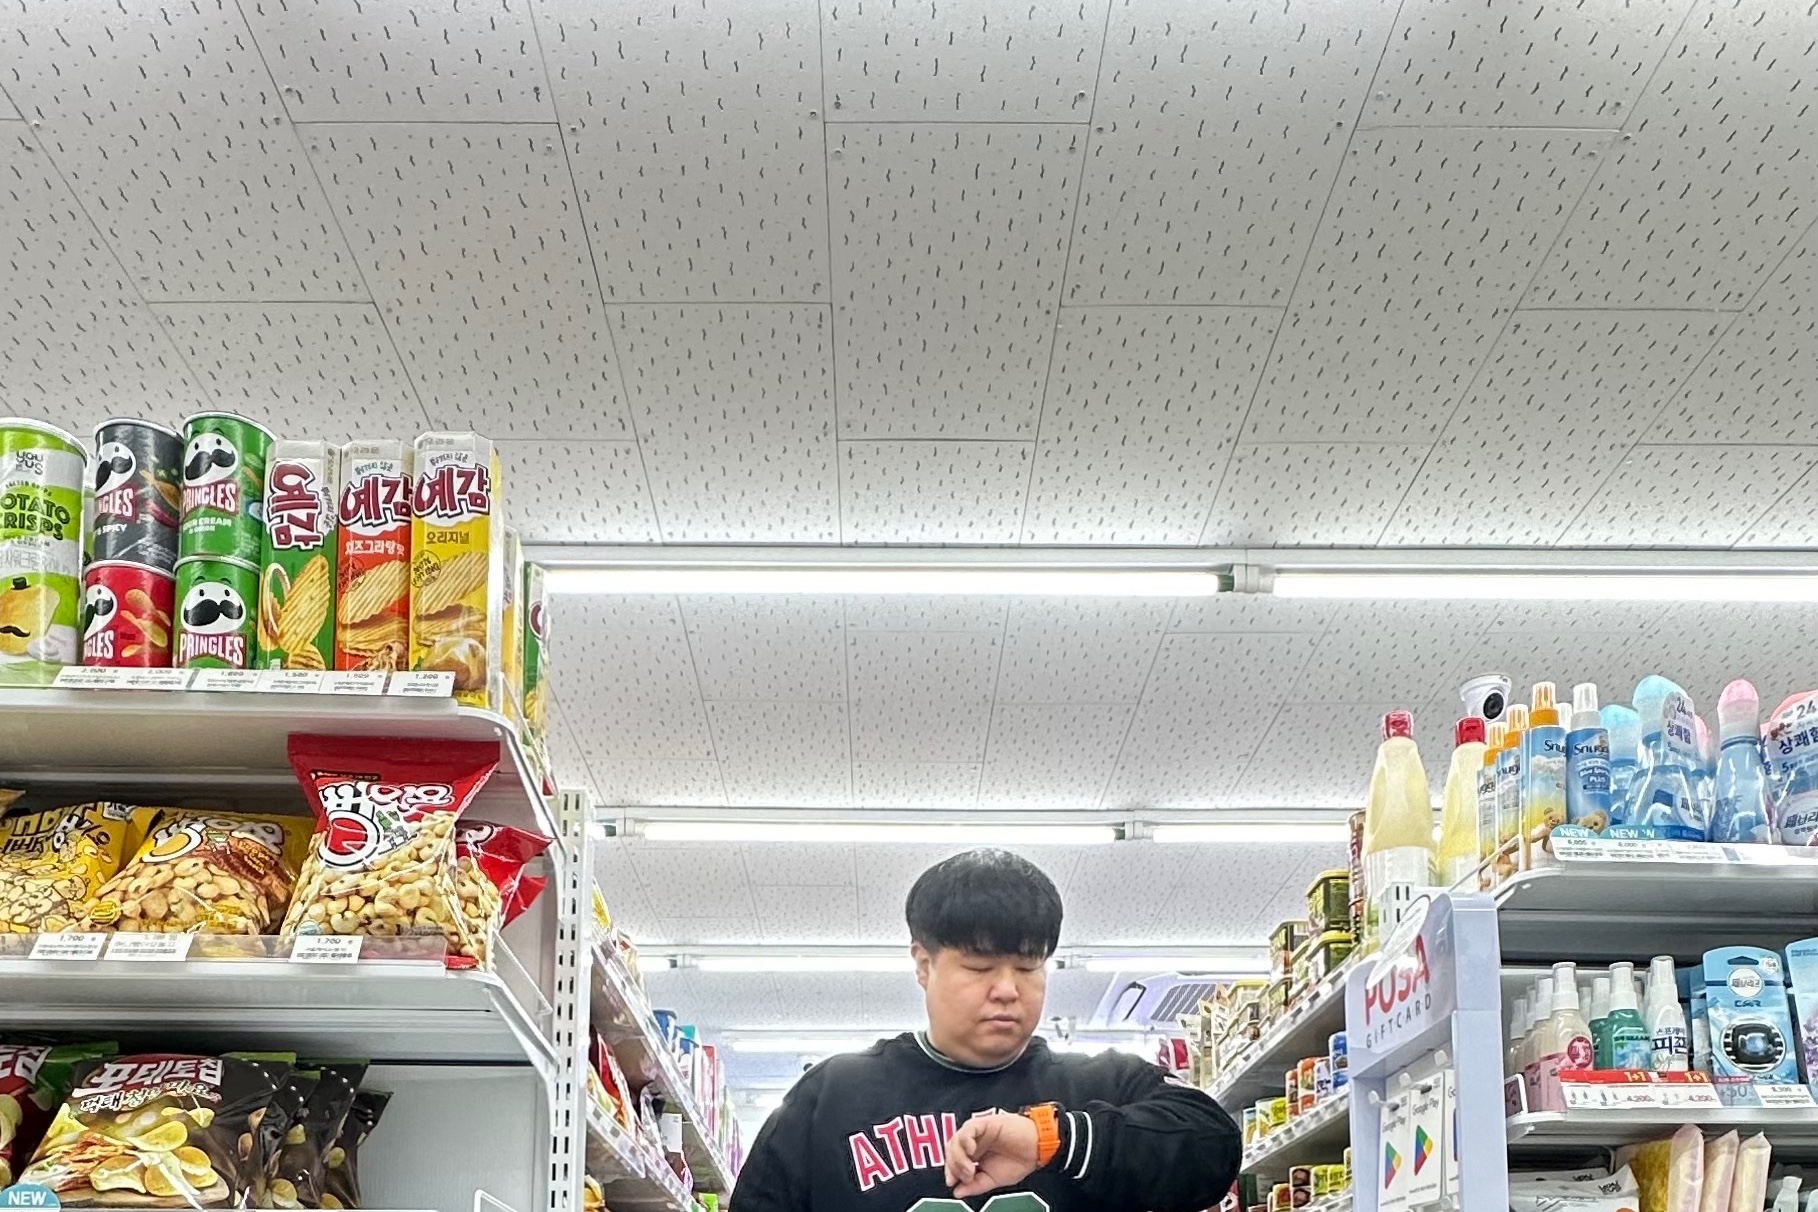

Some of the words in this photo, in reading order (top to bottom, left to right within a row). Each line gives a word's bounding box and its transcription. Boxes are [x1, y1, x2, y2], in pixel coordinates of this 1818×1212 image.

[182, 482, 237, 519] PRINGLES
[341, 475, 413, 521] 예감
[414, 466, 489, 516] 예감
[0, 493, 71, 526] OTATO
[0, 512, 64, 541] RISPS
[426, 531, 471, 545] 오리지널
[86, 630, 115, 658] GLES
[179, 634, 245, 667] PRINGLES
[1559, 828, 1589, 838] NEW
[1609, 829, 1639, 839] NEW
[72, 1056, 224, 1098] 포테토칩
[1626, 1072, 1648, 1083] 1+1
[1686, 1072, 1709, 1083] 1+1
[8, 1191, 47, 1206] NEW
